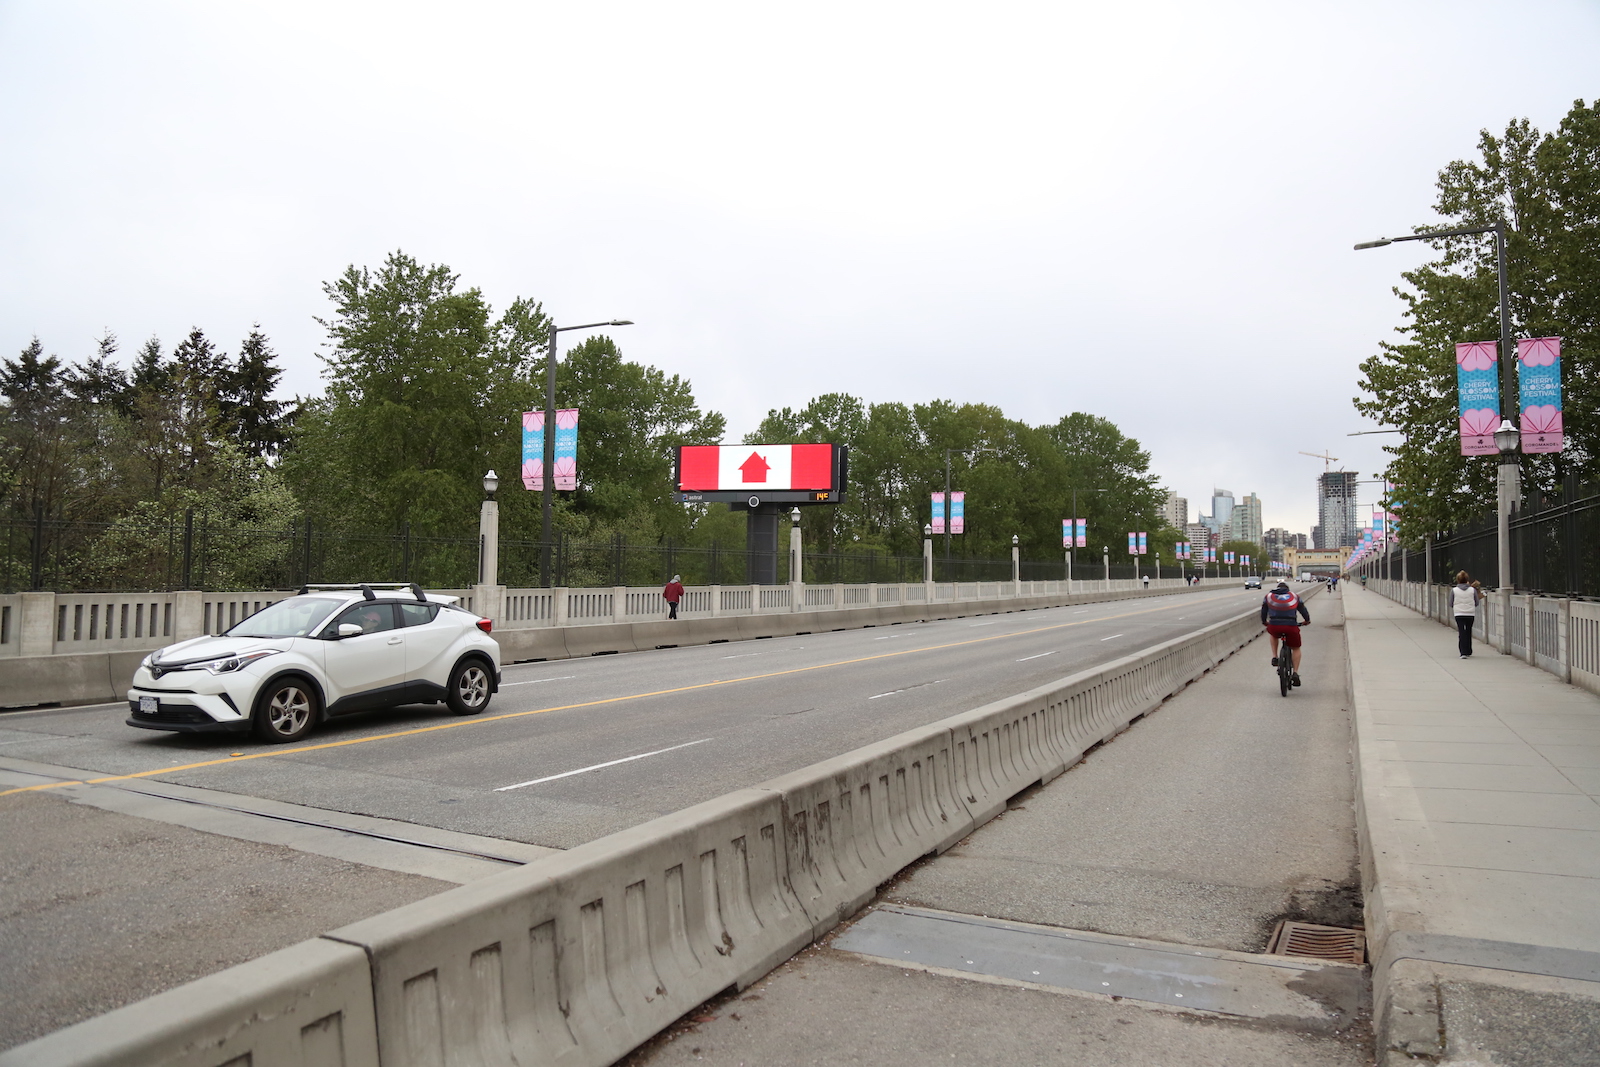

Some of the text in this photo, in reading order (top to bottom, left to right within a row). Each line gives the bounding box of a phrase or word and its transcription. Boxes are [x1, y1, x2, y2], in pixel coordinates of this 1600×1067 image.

[1463, 381, 1492, 389] CHERRY
[1525, 377, 1554, 385] CHERRY
[1459, 387, 1497, 395] BLOSSOM
[1521, 383, 1559, 391] BLOSSOM
